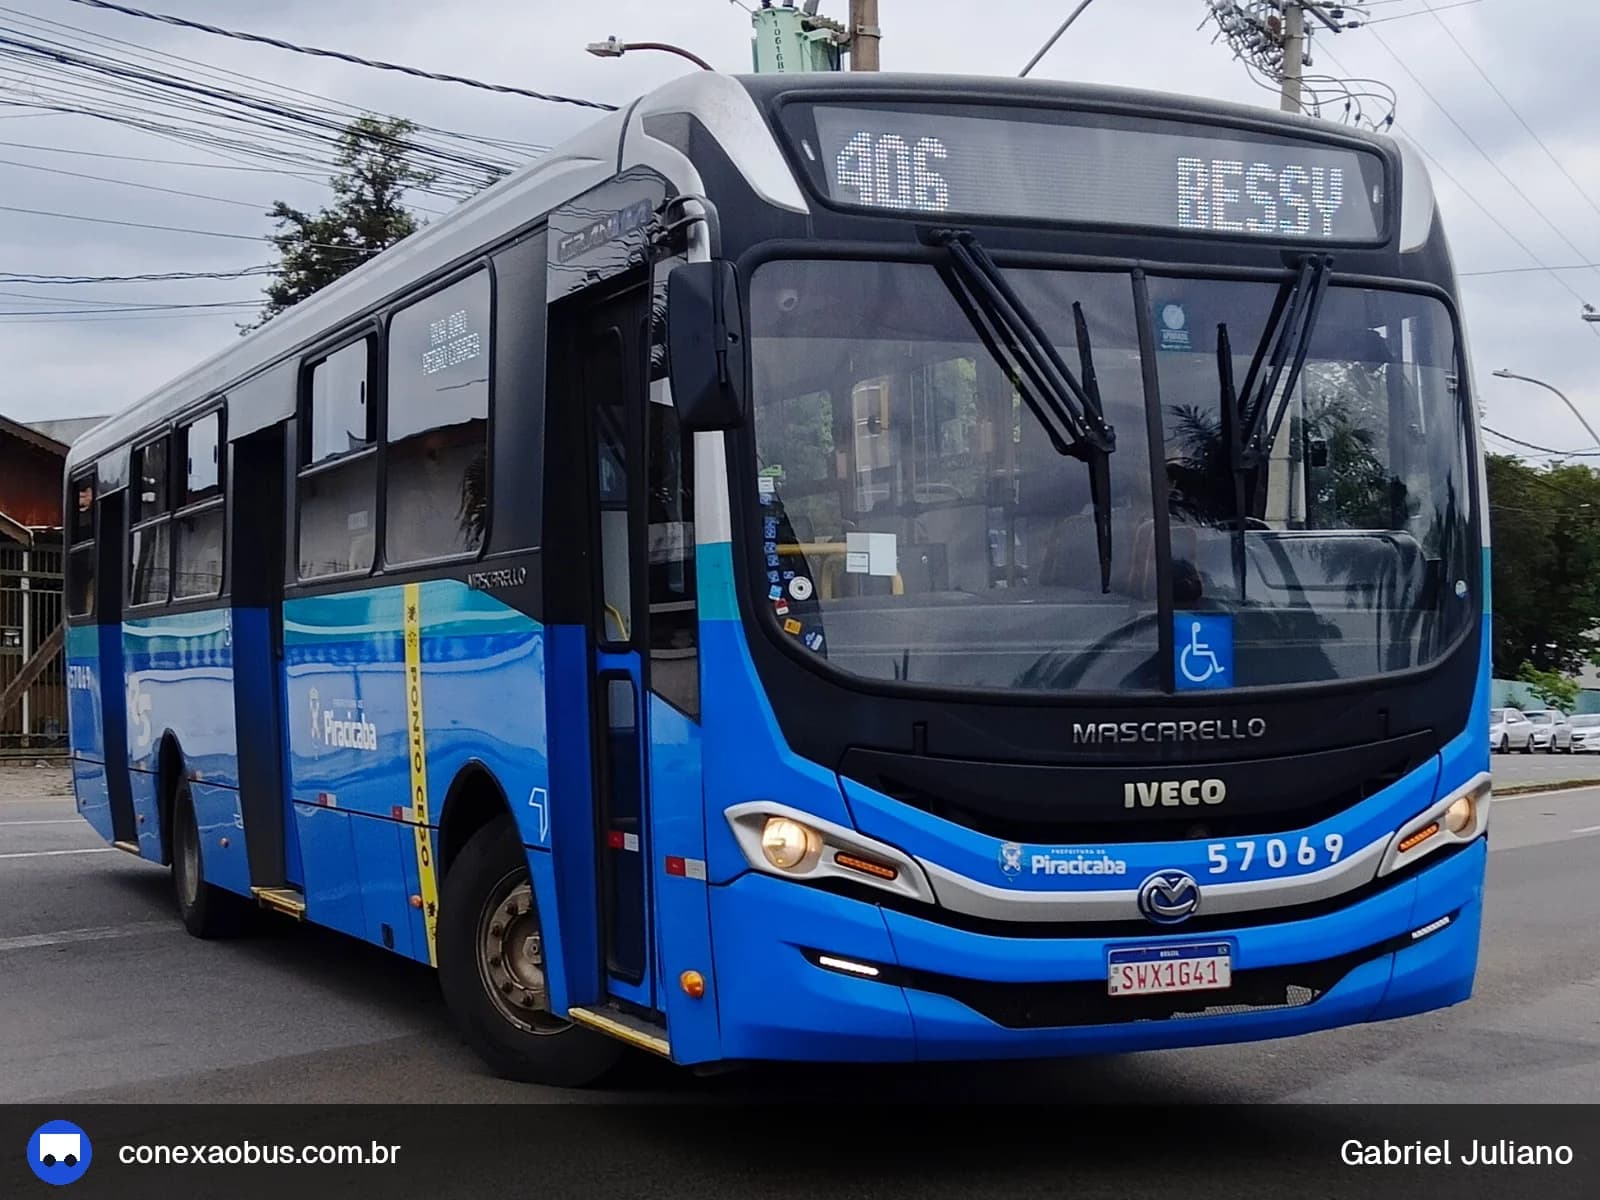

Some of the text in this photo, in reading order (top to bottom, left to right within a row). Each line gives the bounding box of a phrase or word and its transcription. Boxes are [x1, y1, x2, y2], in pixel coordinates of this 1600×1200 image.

[837, 131, 1344, 237] 406 BESSY
[322, 709, 378, 751] Piracicaba
[1072, 717, 1266, 744] MASCARELLO
[409, 666, 429, 867] PONTO CEGO
[1123, 779, 1227, 808] IVECO
[1031, 854, 1127, 876] Piracicaba
[1207, 833, 1344, 874] 57069
[1121, 960, 1219, 991] SWX1G41
